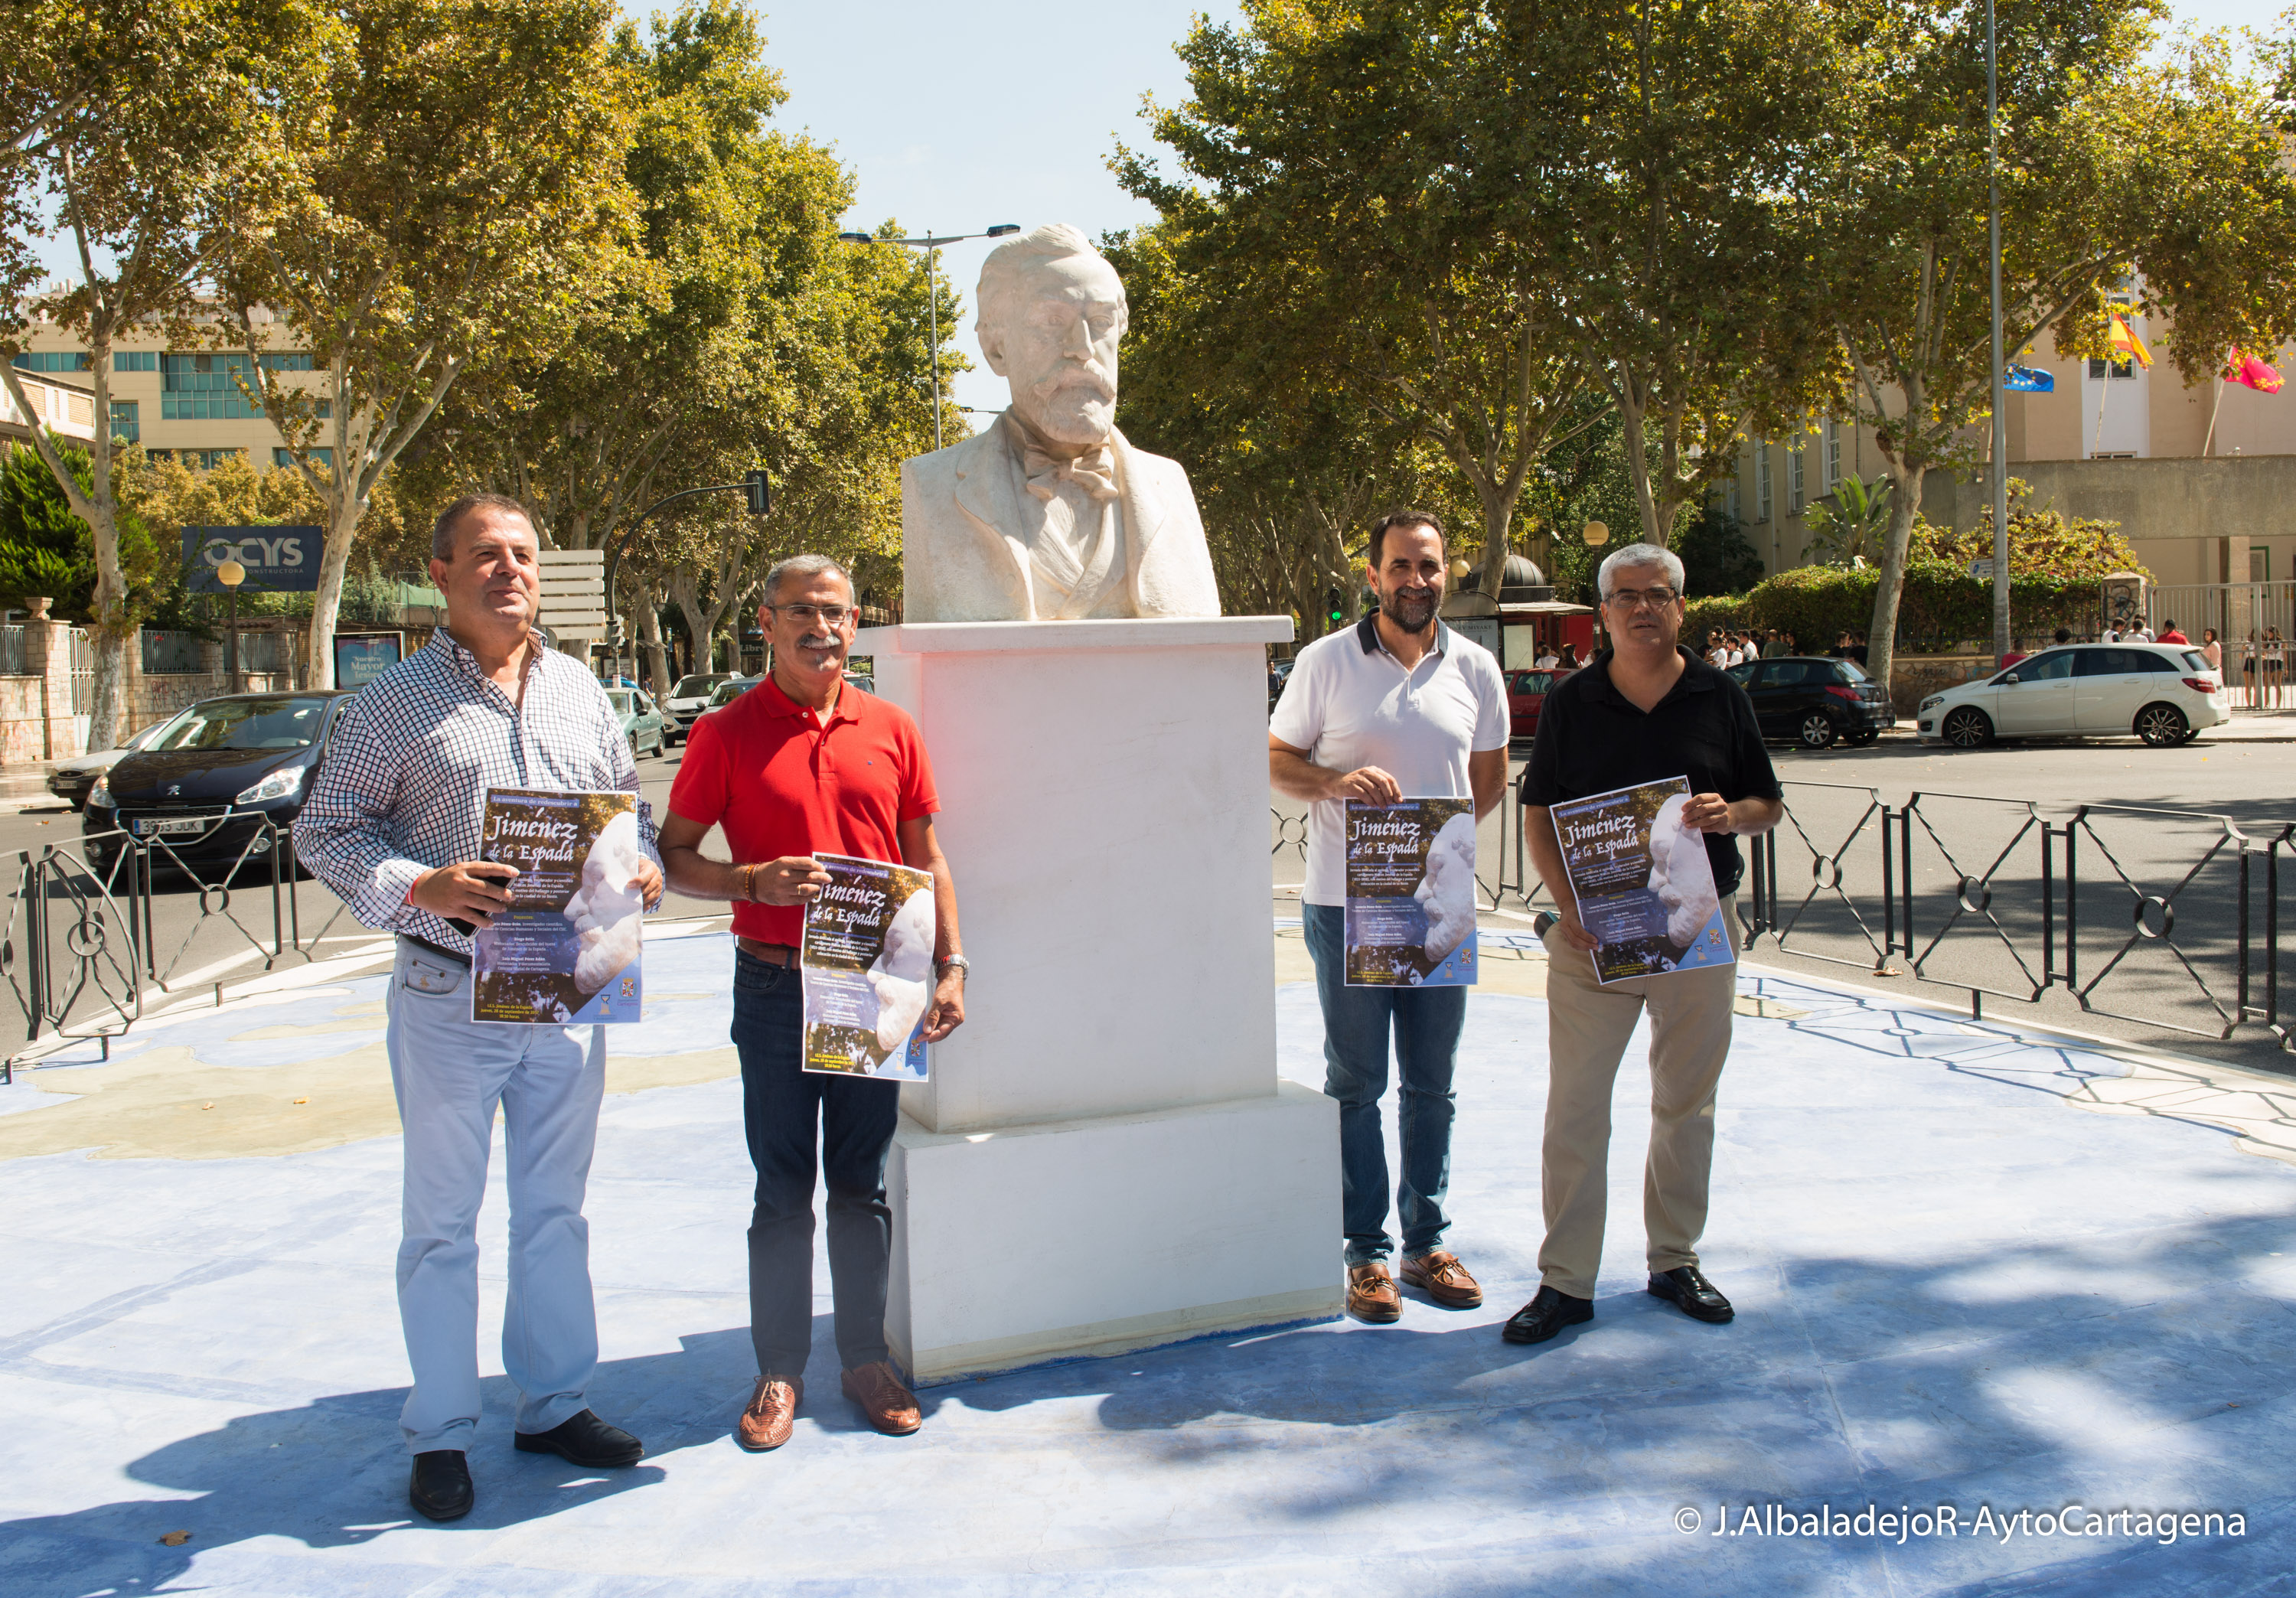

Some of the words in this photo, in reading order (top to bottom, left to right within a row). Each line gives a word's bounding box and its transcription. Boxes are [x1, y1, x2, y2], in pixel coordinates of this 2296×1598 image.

[204, 538, 304, 566] OCYS
[351, 662, 385, 673] Mayor
[1596, 799, 1623, 808] redescubrir
[486, 807, 578, 840] Jiménez
[1349, 810, 1420, 840] Jiménez
[1565, 809, 1636, 848] Jiménez
[490, 844, 500, 857] de
[503, 845, 514, 859] la
[519, 840, 573, 870] Espada
[1353, 843, 1362, 854] de
[1365, 843, 1372, 853] la
[1377, 837, 1419, 862] Espada
[1573, 848, 1580, 859] de
[1583, 845, 1592, 857] la
[1594, 829, 1639, 860] Espada
[811, 876, 886, 907] Jiménez
[814, 906, 823, 918] de
[824, 907, 833, 921] la
[836, 907, 880, 932] Espada
